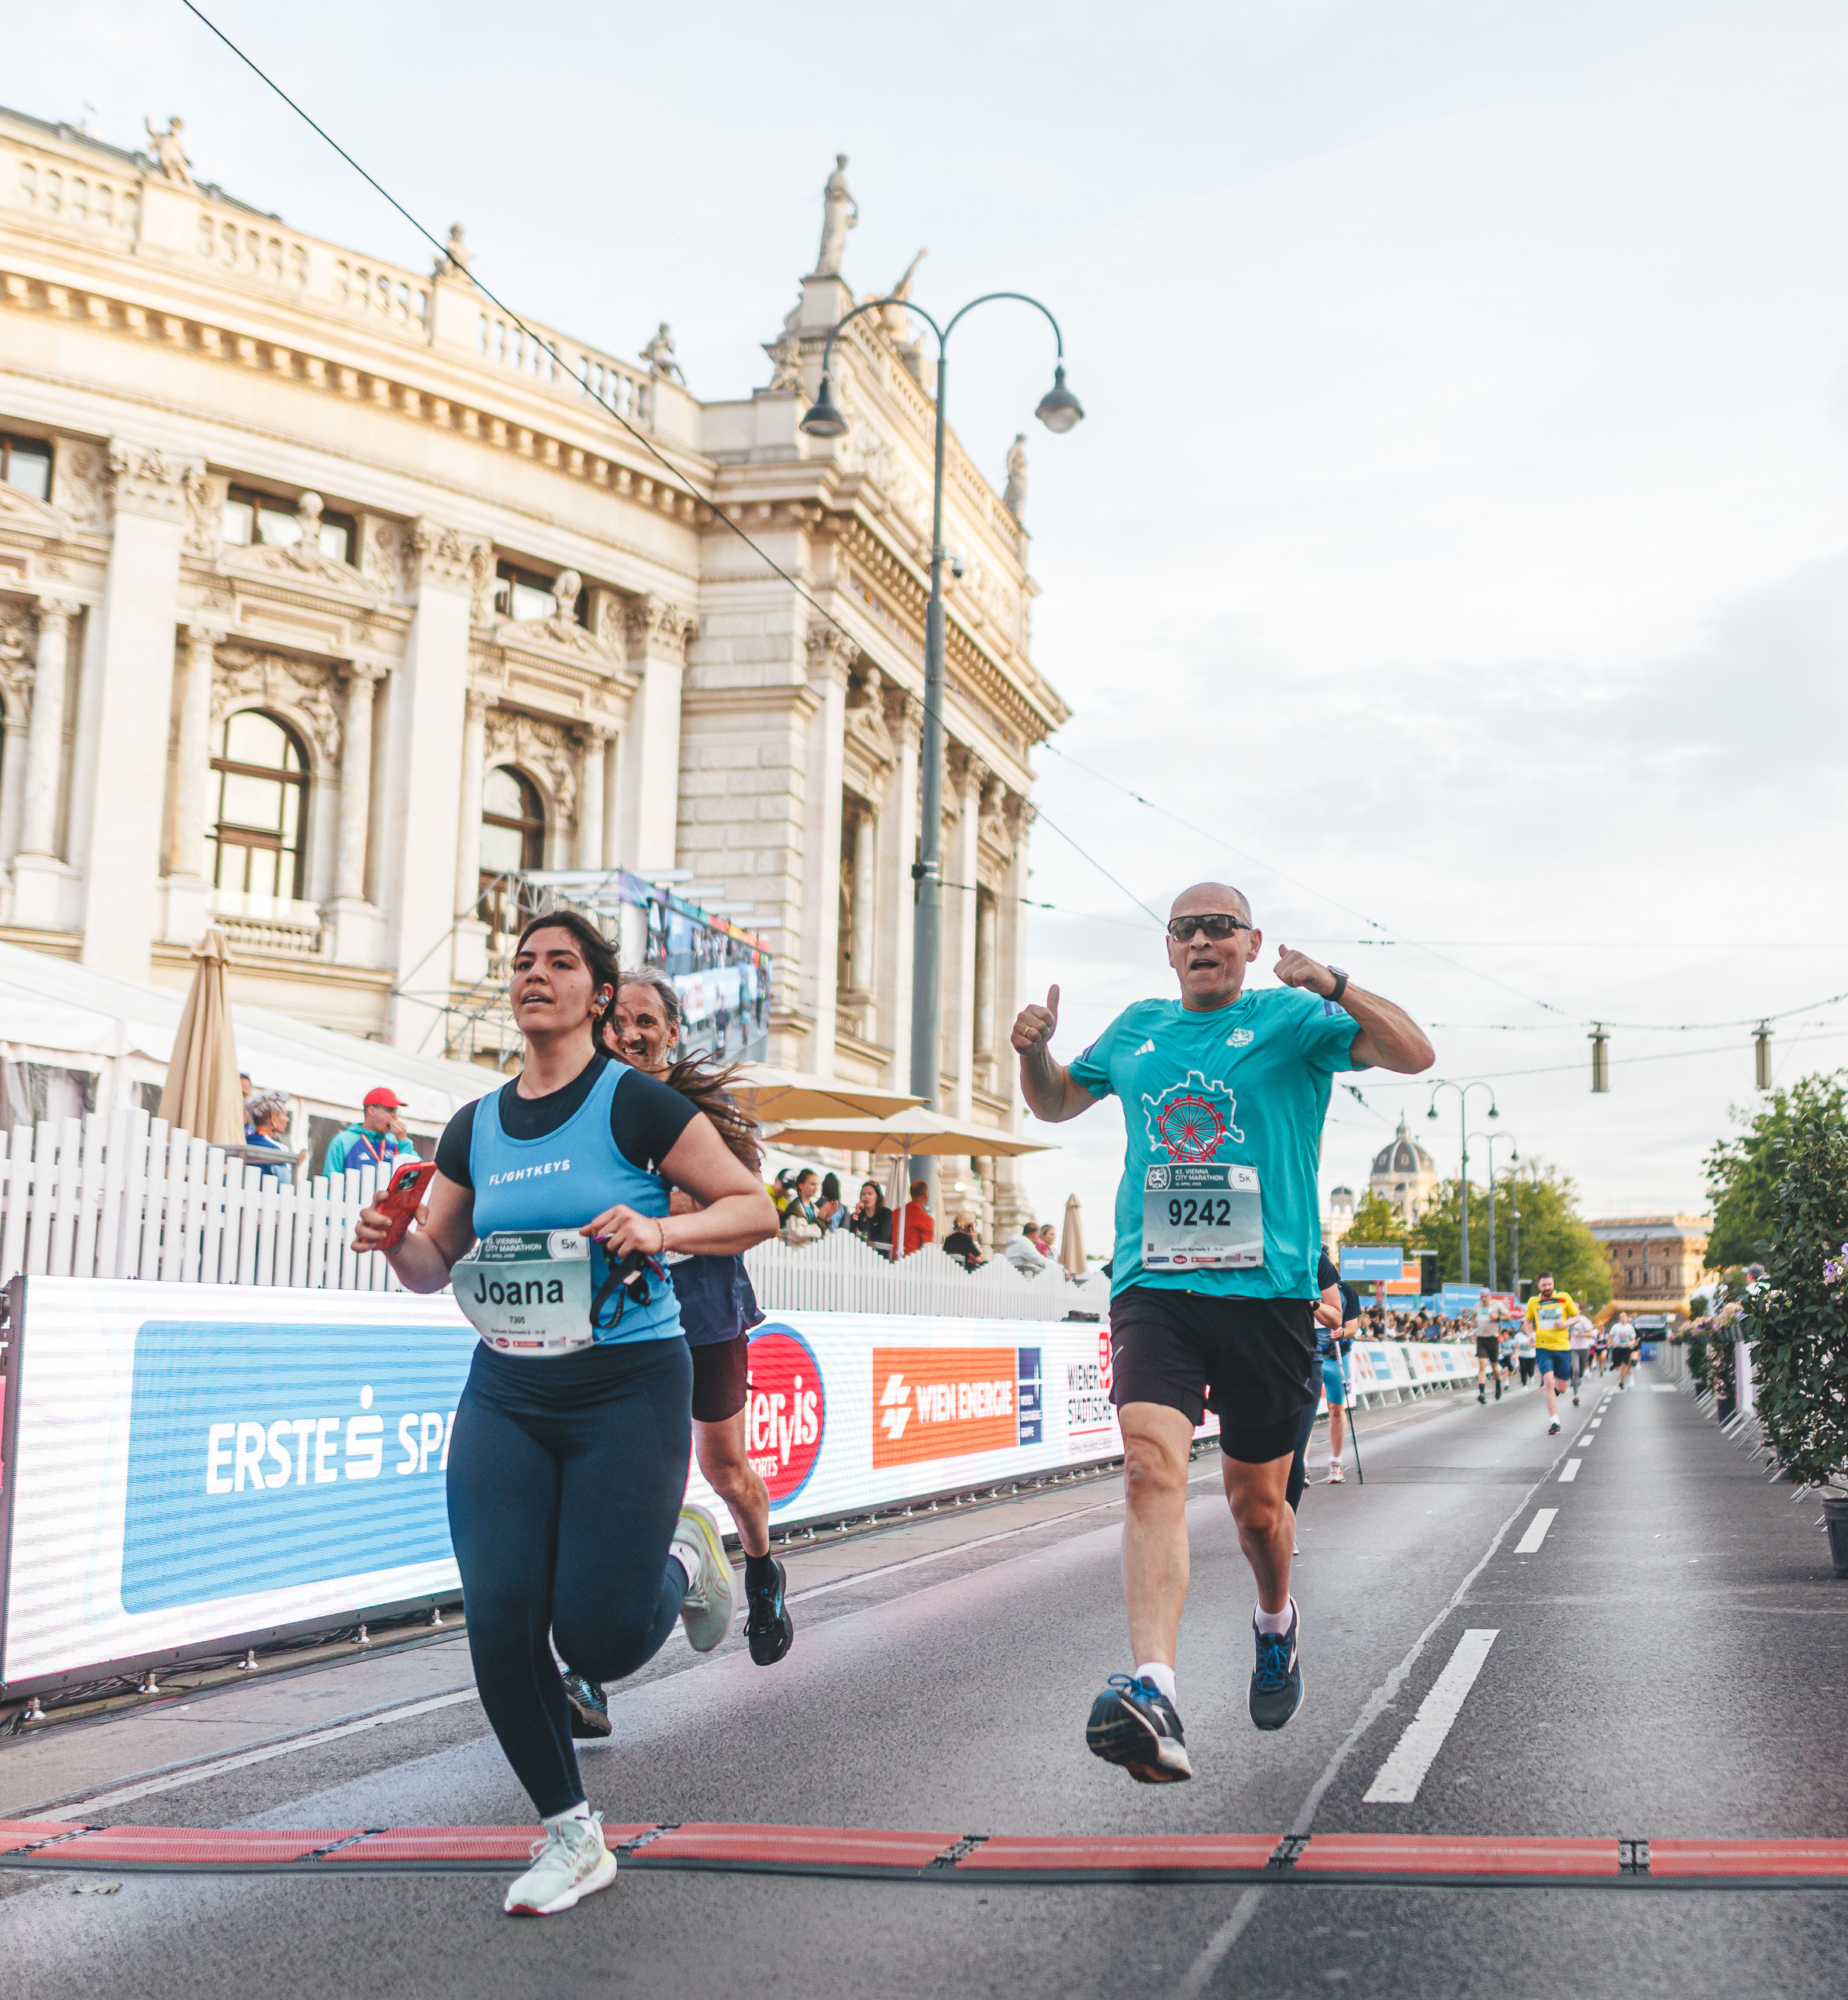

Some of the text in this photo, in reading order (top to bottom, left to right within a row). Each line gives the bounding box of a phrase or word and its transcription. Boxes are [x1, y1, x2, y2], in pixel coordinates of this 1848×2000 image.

[488, 1159, 571, 1186] FLIGHTKEYS
[1169, 1198, 1231, 1226] 9242
[499, 1243, 543, 1253] MARATHON
[474, 1273, 564, 1305] Joana
[1067, 1364, 1098, 1392] WIENER
[915, 1380, 1013, 1424] WIEN ENERGIE
[206, 1418, 340, 1495] ERSTE
